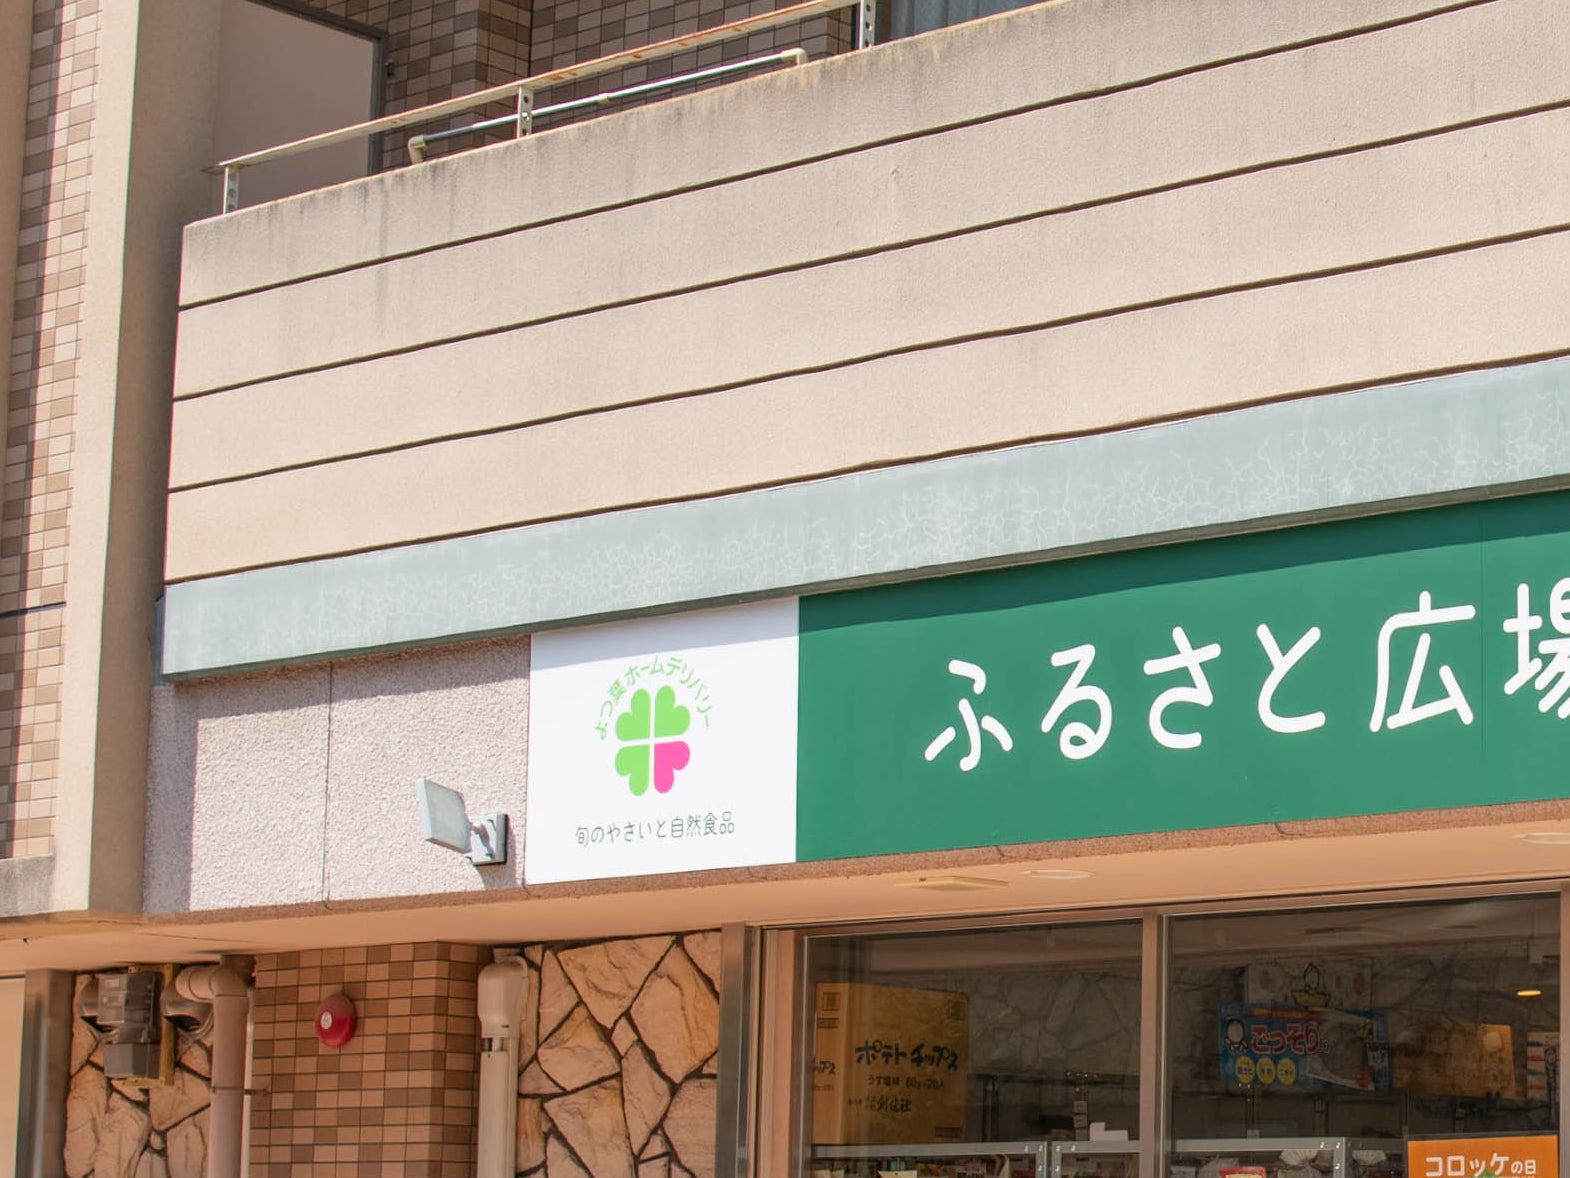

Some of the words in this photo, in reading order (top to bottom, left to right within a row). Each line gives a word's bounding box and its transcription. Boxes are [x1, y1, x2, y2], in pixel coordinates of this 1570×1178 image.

[594, 655, 713, 740] よつ葉ホームデリバリー
[575, 811, 736, 848] 旬のやさいと自然食品
[1425, 1152, 1537, 1177] コロッケの日
